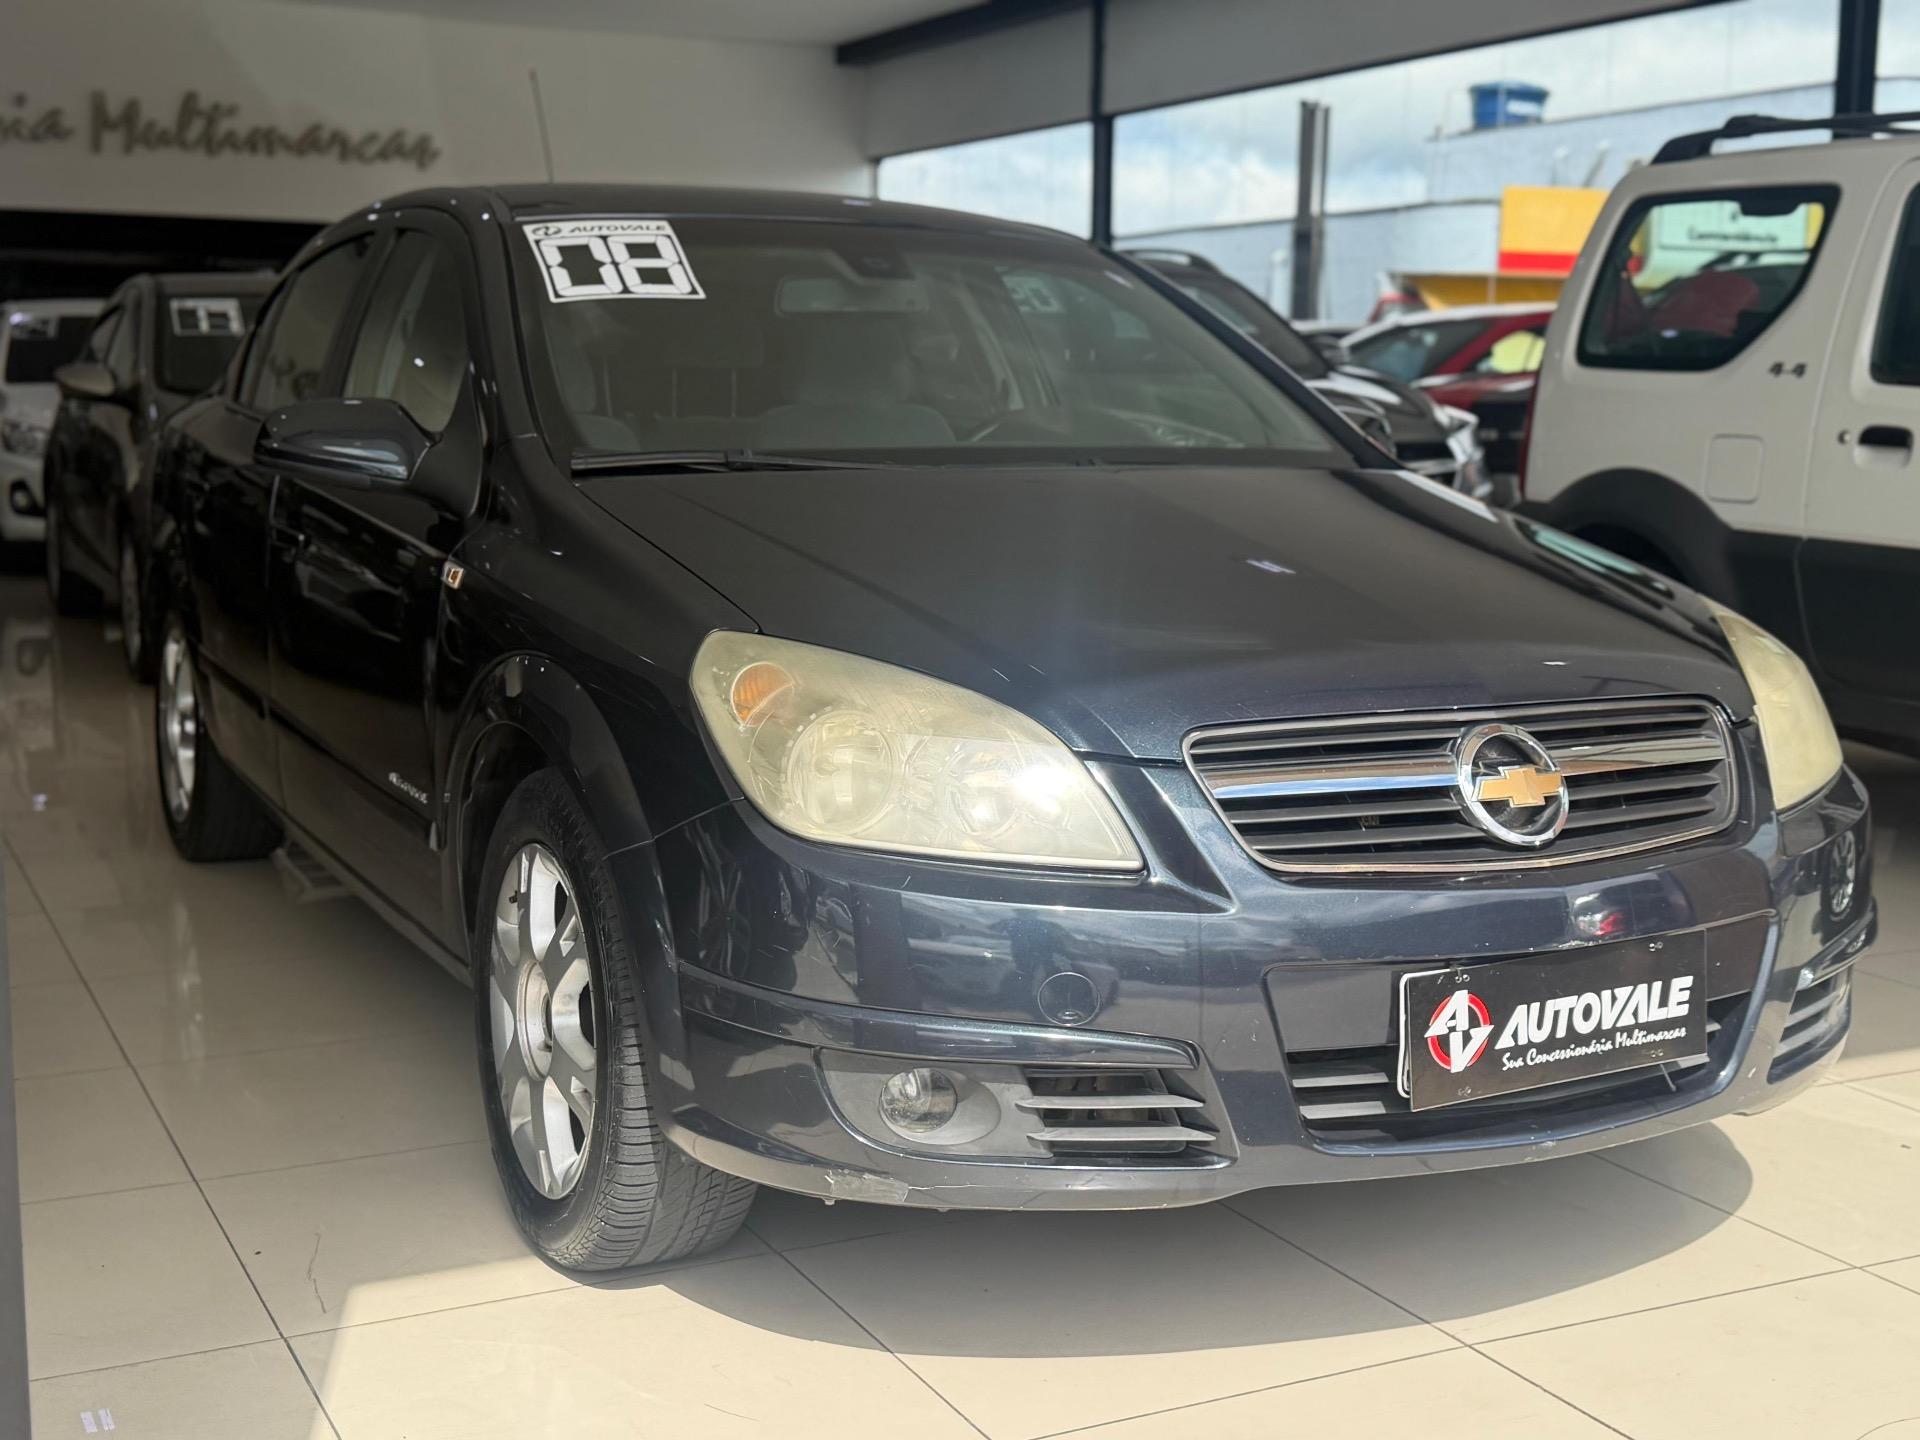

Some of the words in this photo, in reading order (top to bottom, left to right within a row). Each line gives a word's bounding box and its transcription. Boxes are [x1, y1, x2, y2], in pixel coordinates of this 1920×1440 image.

[90, 90, 441, 170] Multimarcas
[569, 224, 666, 233] AUTOVALE
[539, 236, 693, 296] 08
[1494, 975, 1694, 1050] AUTOVALE
[1502, 1052, 1525, 1071] Sua
[1527, 1039, 1613, 1066] Concessionária
[1615, 1026, 1687, 1049] Multimarcas
